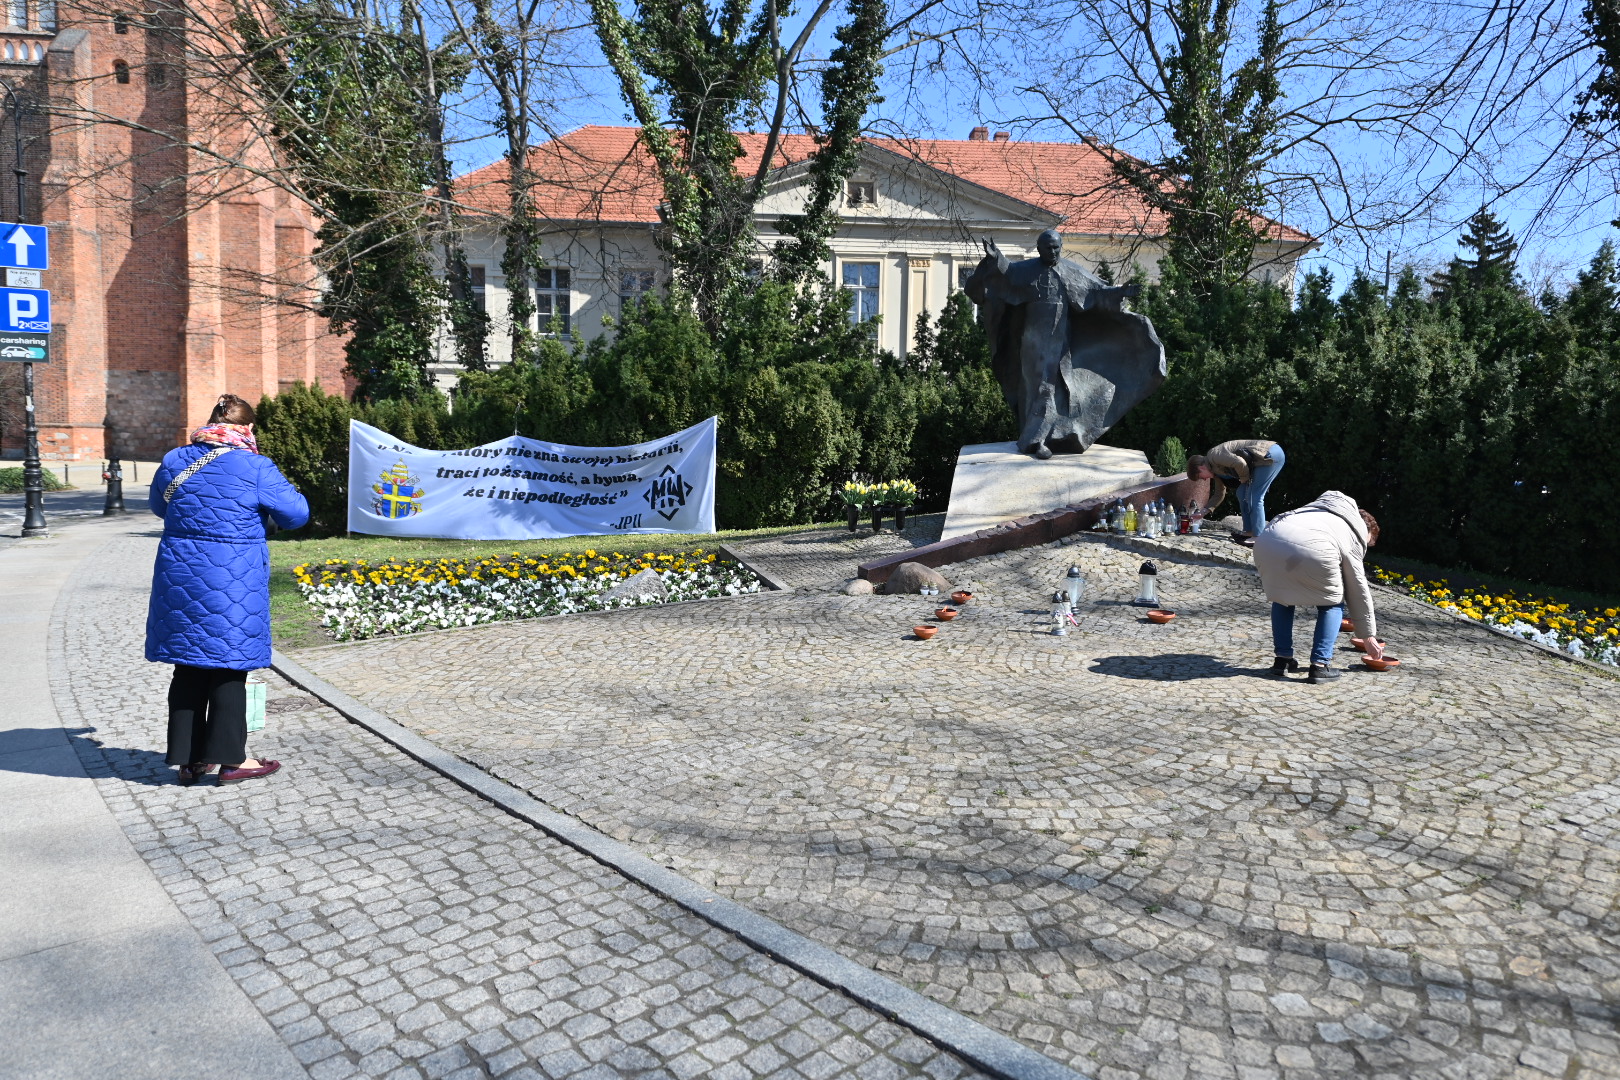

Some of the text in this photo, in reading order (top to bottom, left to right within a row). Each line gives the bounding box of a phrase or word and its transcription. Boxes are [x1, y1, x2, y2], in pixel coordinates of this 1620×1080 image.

[8, 293, 38, 327] P
[0, 337, 46, 346] carsharing
[504, 444, 532, 458] nie
[533, 450, 560, 463] zna
[436, 465, 643, 487] traci tożsamość, a bywa,
[462, 485, 485, 498] że
[486, 485, 497, 499] i
